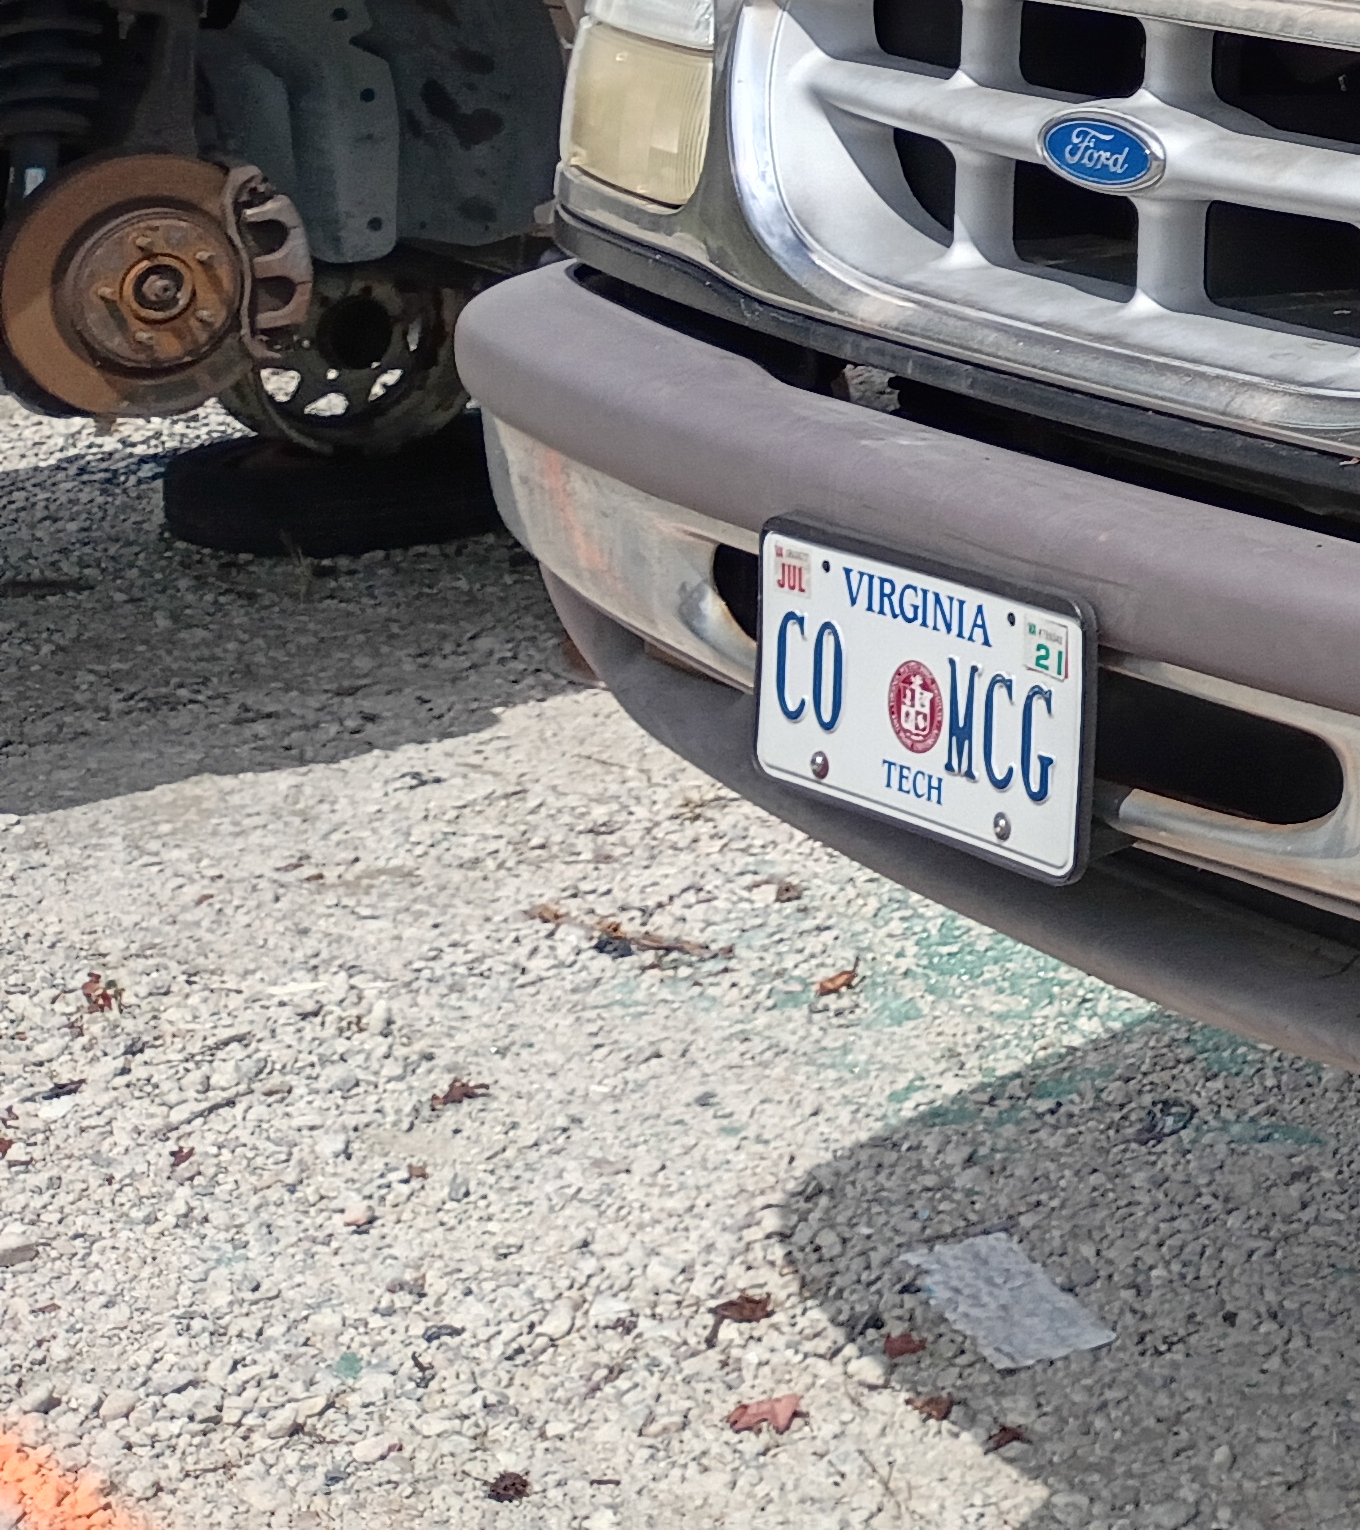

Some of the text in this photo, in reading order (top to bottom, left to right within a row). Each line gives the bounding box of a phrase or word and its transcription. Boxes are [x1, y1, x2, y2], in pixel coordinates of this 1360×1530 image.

[1065, 127, 1130, 173] Ford
[776, 562, 806, 593] JUL
[843, 567, 992, 647] VIRGINIA
[1035, 643, 1063, 676] 21
[776, 610, 843, 731] CO
[944, 656, 1054, 802] MCG
[882, 759, 943, 805] TECH
